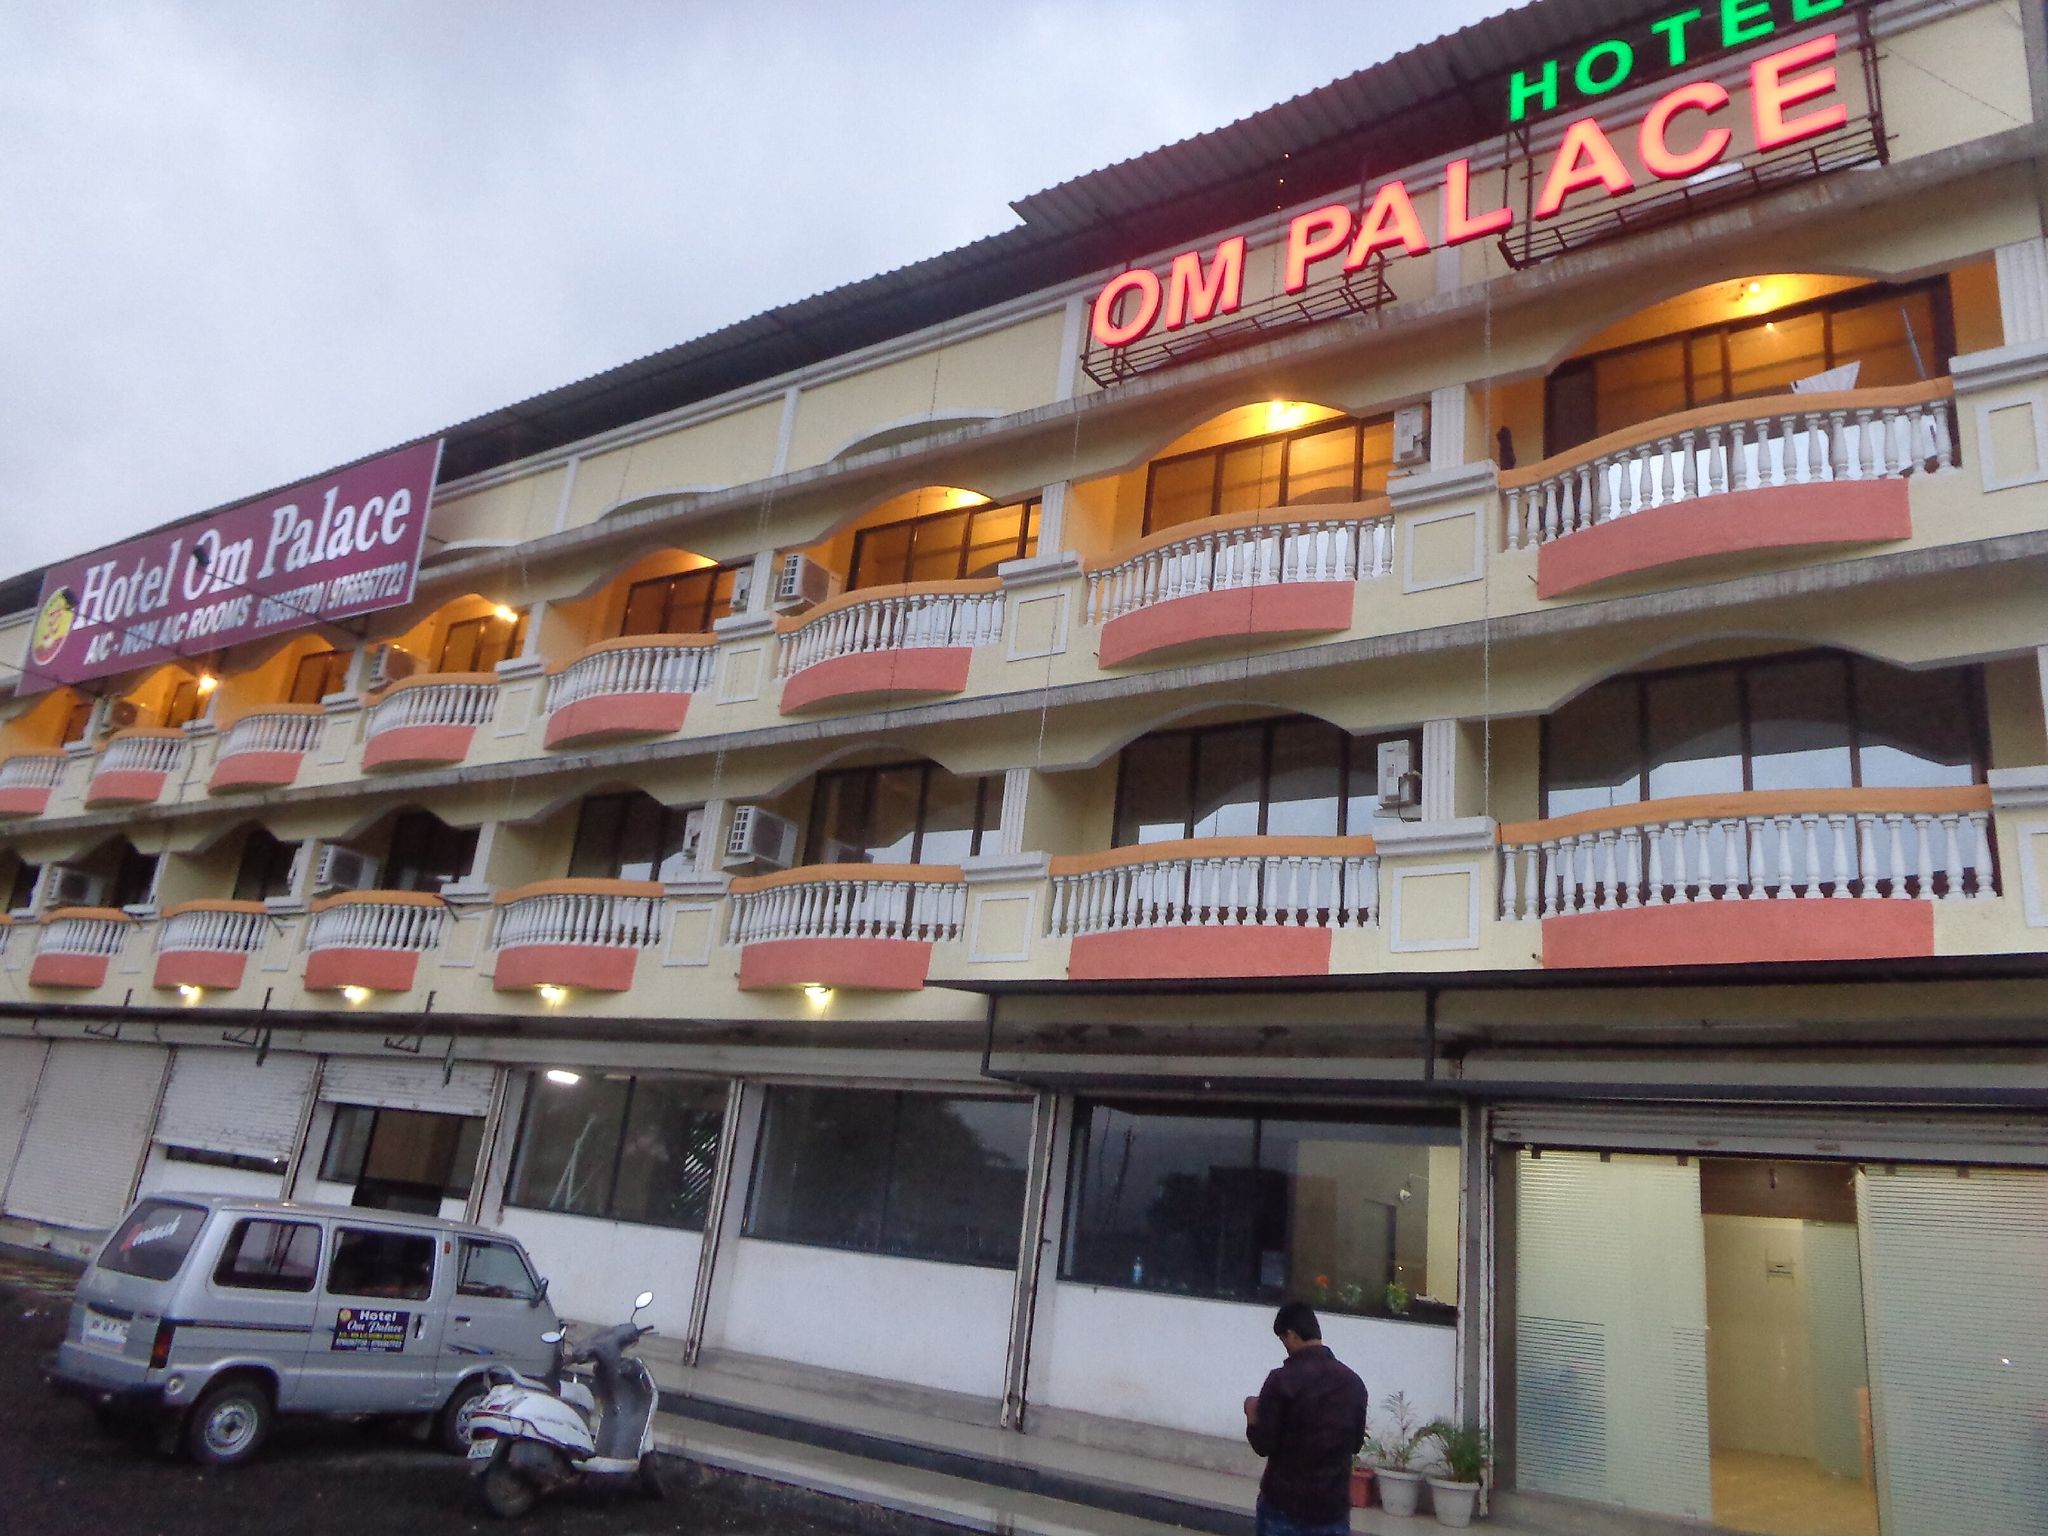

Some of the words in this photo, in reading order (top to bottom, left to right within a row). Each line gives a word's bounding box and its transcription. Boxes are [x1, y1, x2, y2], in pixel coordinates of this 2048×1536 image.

[1090, 236, 1247, 347] OM
[1285, 35, 1847, 294] PALACE
[72, 539, 180, 630] Hotel
[183, 529, 253, 601] Om
[257, 486, 411, 580] Palace
[187, 595, 253, 639] ROOMS
[361, 1310, 397, 1321] Hotel
